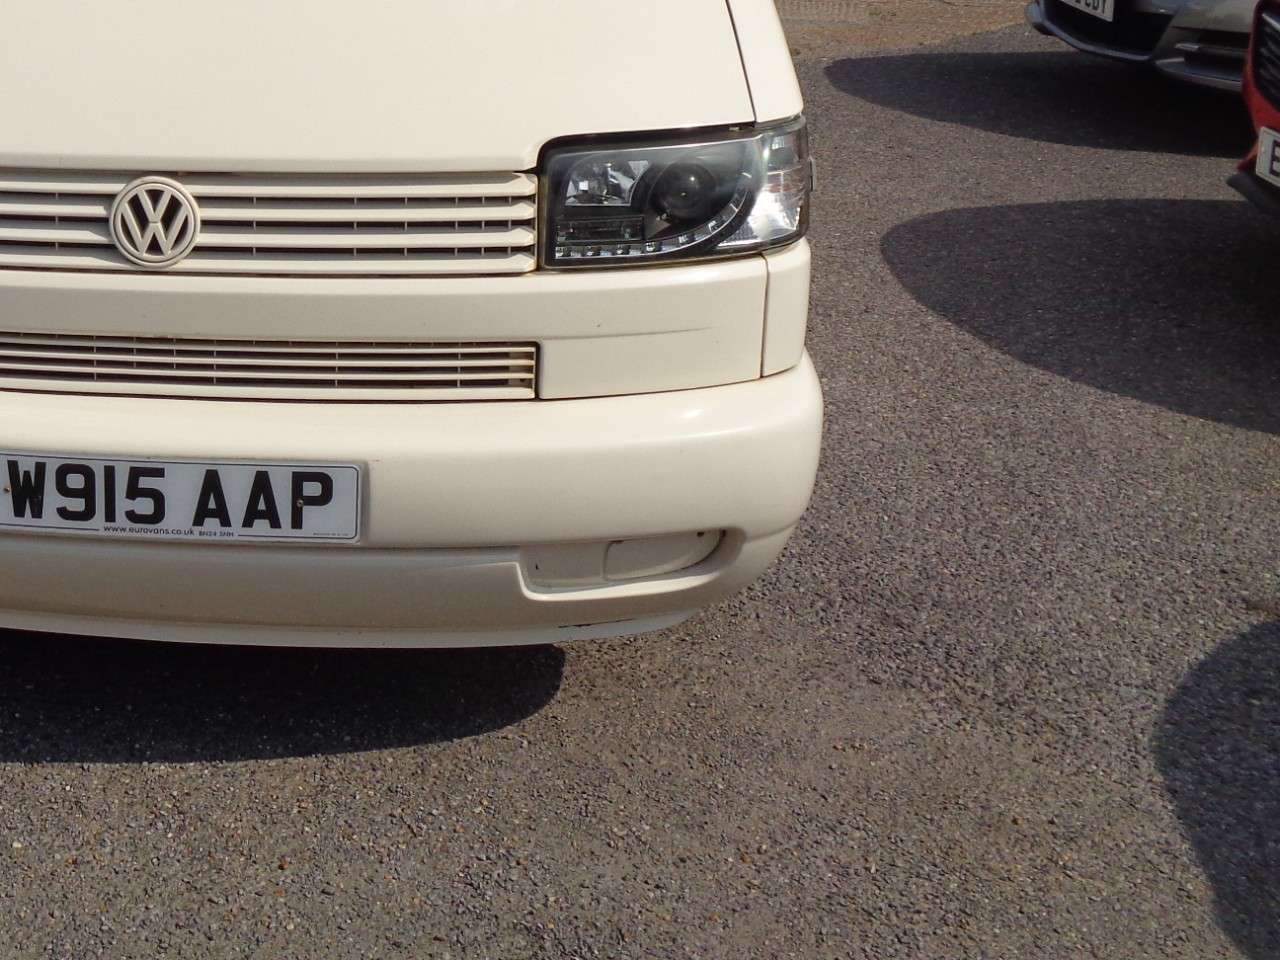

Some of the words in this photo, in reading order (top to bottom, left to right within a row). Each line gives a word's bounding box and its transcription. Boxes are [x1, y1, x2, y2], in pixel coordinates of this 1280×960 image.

[7, 460, 166, 525] W915
[192, 469, 334, 530] AAP
[103, 525, 195, 536] www.eurovans.co.uk
